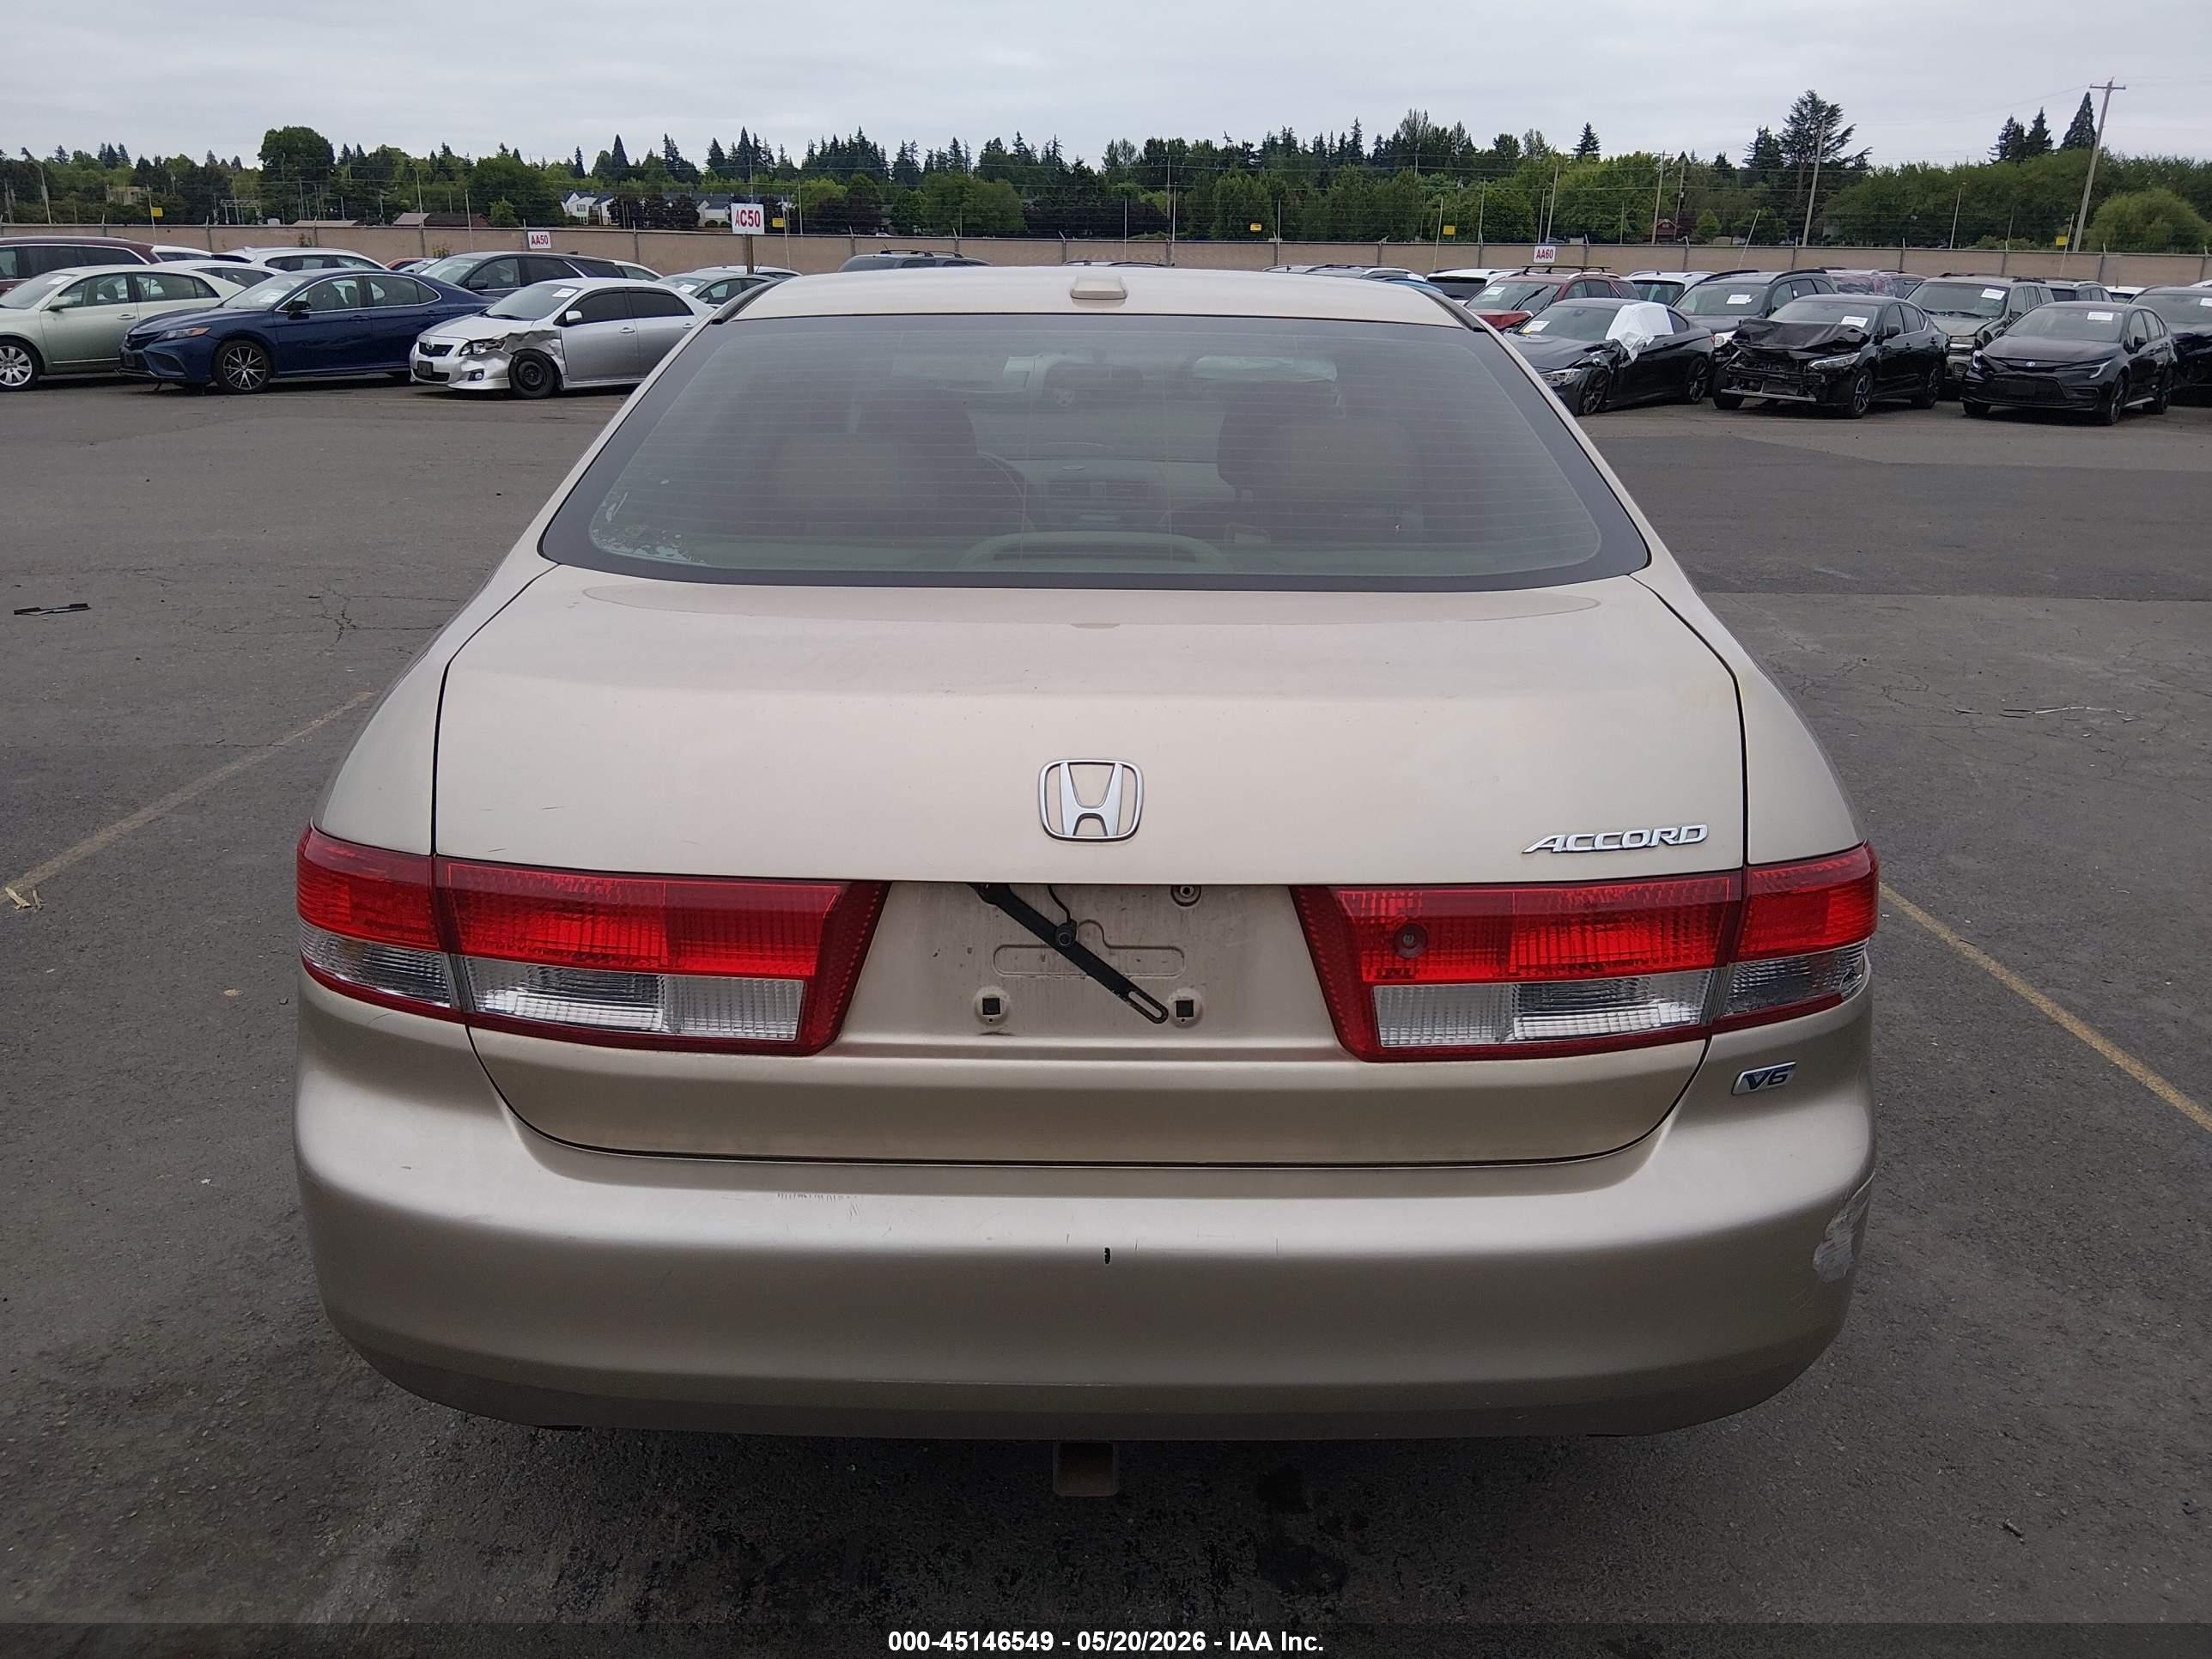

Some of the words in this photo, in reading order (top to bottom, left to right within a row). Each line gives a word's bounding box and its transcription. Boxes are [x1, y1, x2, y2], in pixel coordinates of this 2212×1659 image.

[735, 210, 761, 228] AC50
[531, 234, 549, 246] AA50
[1536, 249, 1553, 259] AA60
[1522, 823, 1708, 854] ACCORD
[1741, 1067, 1791, 1091] V6
